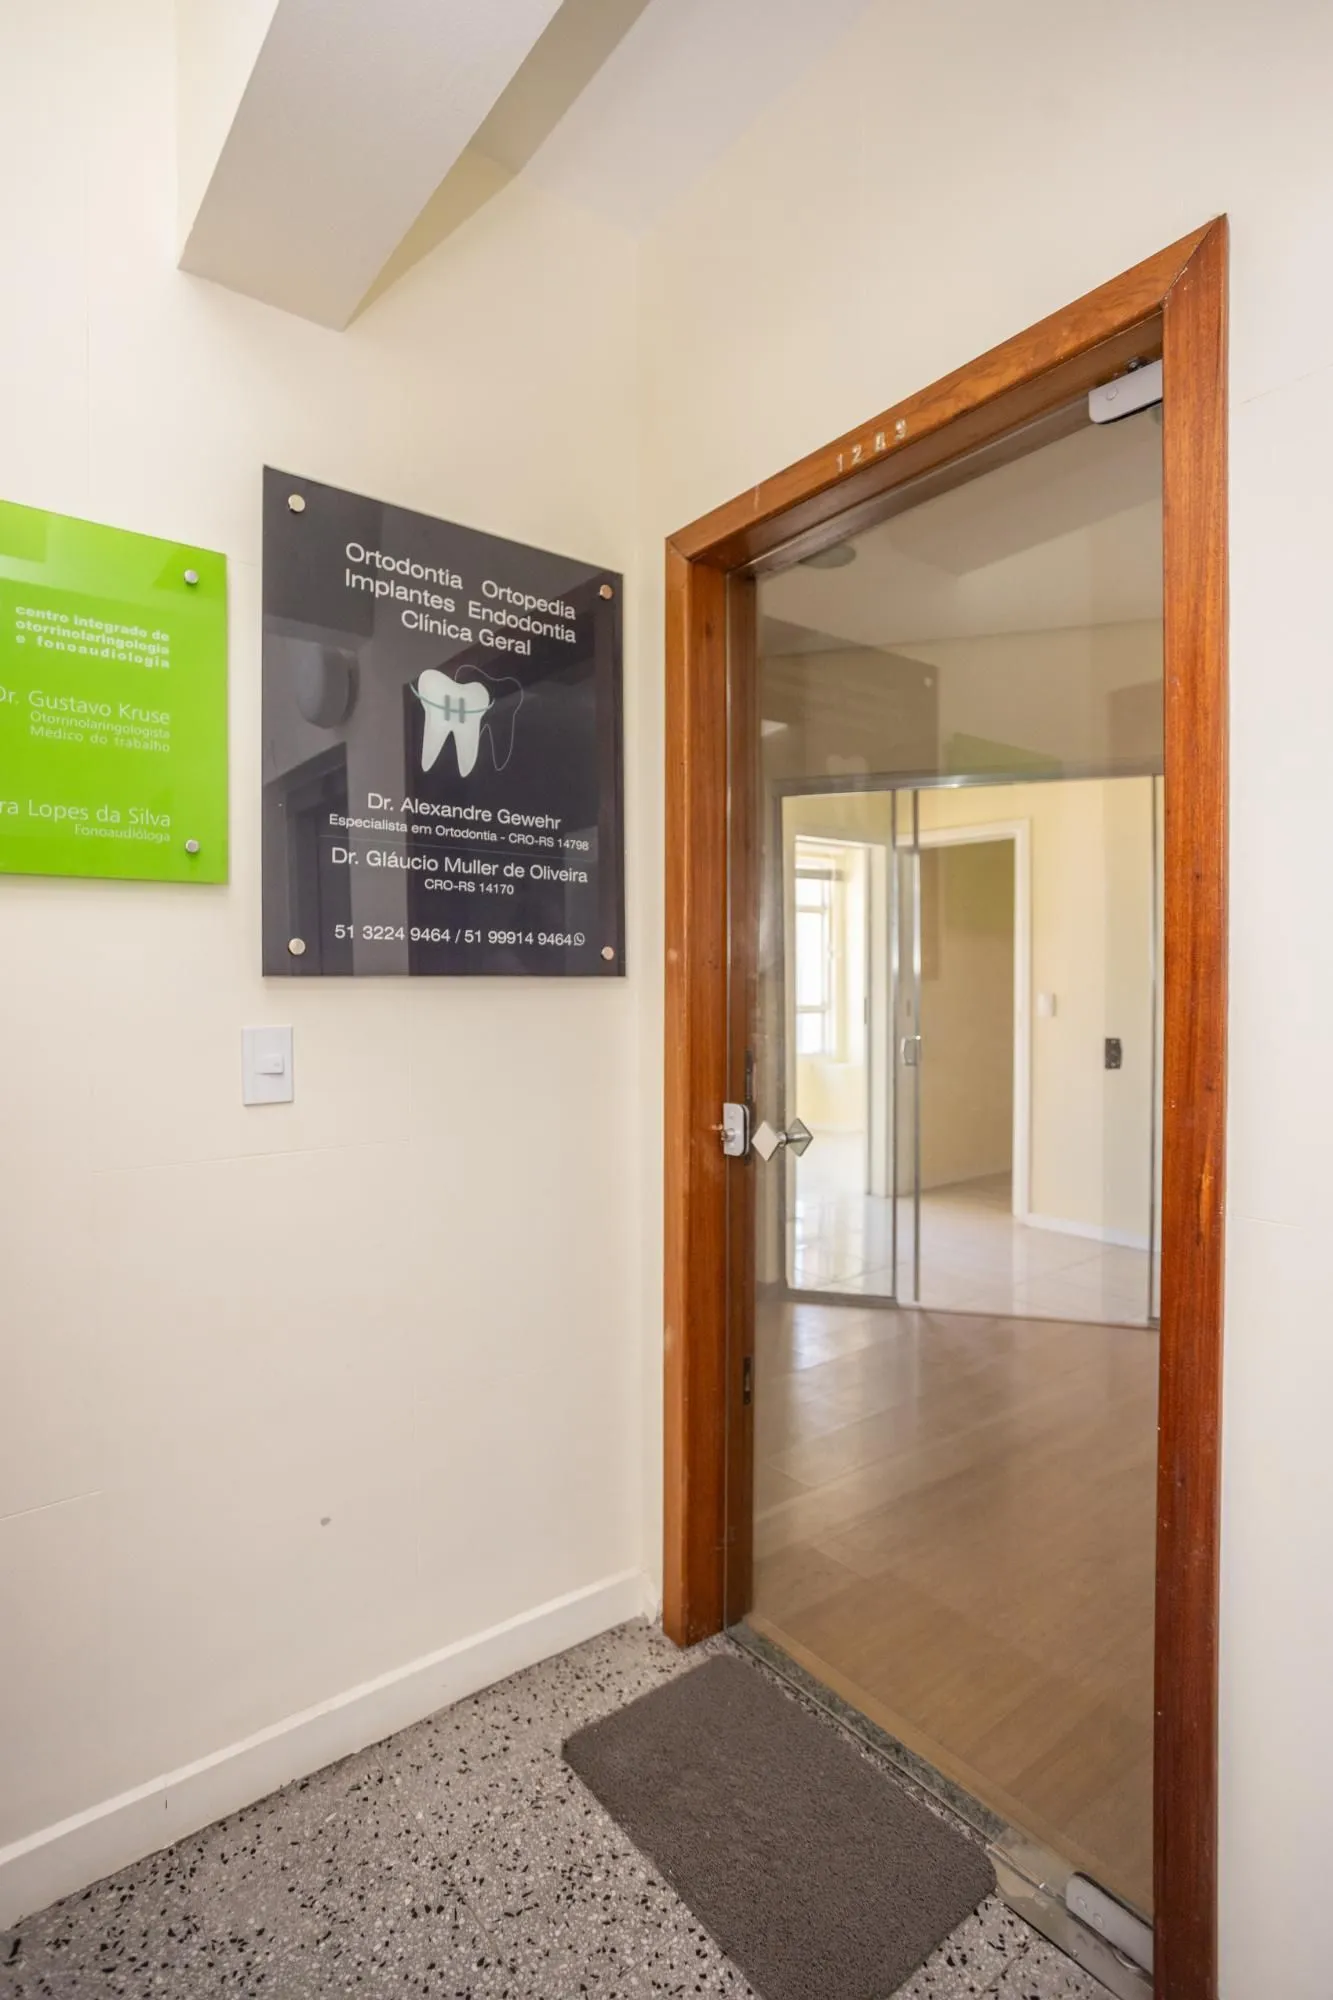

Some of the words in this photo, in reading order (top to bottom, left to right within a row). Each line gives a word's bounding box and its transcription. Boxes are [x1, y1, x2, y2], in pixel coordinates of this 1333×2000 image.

[345, 542, 463, 590] Ortodontia
[481, 579, 576, 620] Ortopedia
[15, 605, 69, 623] centro
[74, 614, 147, 638] integrado
[152, 629, 170, 642] de
[345, 568, 456, 613] Implantes
[468, 600, 576, 644] Endodontia
[15, 619, 170, 655] otorrinolaringologia
[401, 609, 473, 643] Clínica
[478, 628, 531, 656] Geral
[15, 634, 26, 644] e
[36, 635, 170, 669] fonoaudiologia
[28, 690, 112, 717] Gustavo
[119, 703, 170, 725] Kruse
[30, 711, 170, 739] Otorrinolaringologista
[90, 732, 108, 745] do
[115, 737, 170, 752] trabalho
[28, 799, 89, 823] Lopes
[96, 804, 121, 824] da
[128, 808, 171, 828] Silva
[367, 792, 394, 811] Dr.
[400, 797, 493, 823] Alexandre
[497, 809, 562, 830] Gewehr
[329, 813, 408, 833] Especialista
[411, 823, 432, 836] em
[435, 824, 498, 842] Ortodontia
[508, 832, 555, 848] CRO-RS
[557, 839, 589, 851] 14798
[331, 847, 359, 865] Dr.
[366, 849, 439, 872] Gláucio
[444, 856, 499, 877] Muller
[503, 862, 525, 879] de
[529, 863, 588, 884] Oliveira
[424, 878, 476, 893] CRO-RS
[479, 882, 514, 895] 14170
[334, 924, 355, 940] 51
[362, 925, 405, 941] 3224
[410, 927, 451, 943] 9464
[464, 929, 482, 944] 51
[487, 930, 534, 945] 99914
[537, 932, 572, 947] 9464
